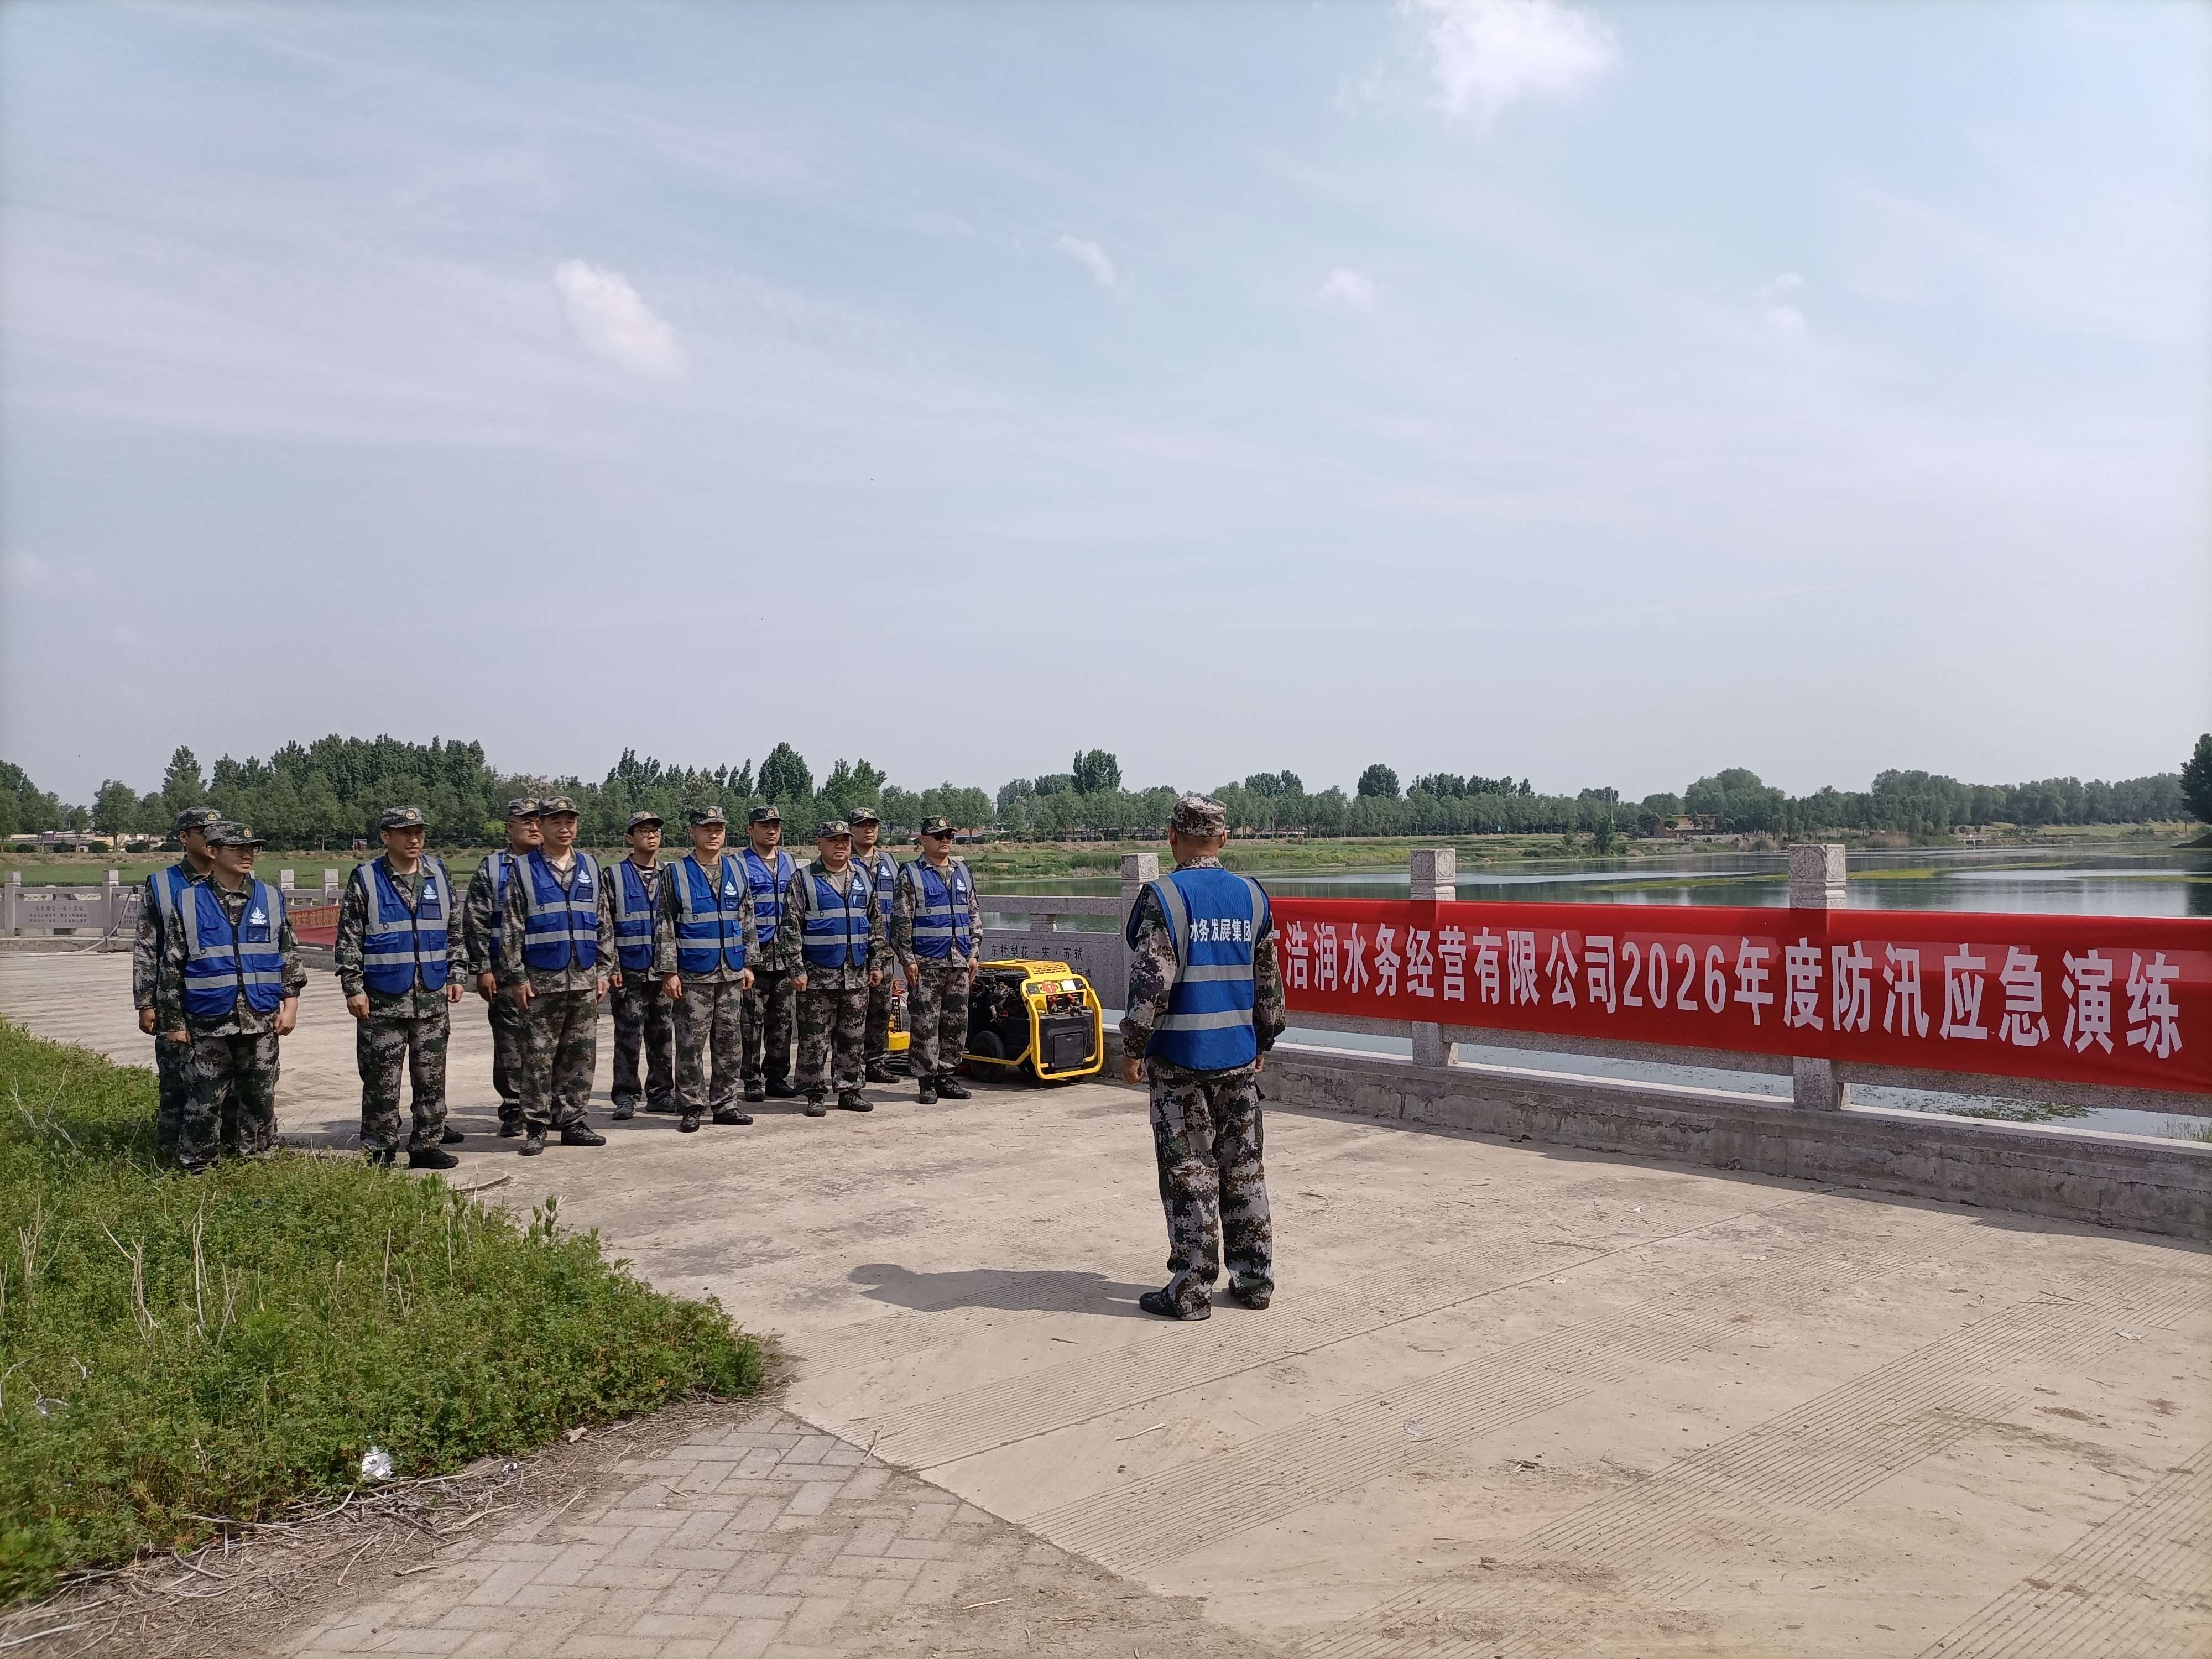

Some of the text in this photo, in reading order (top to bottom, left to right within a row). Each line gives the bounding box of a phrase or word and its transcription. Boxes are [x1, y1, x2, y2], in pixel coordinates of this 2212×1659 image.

[1190, 918, 1251, 942] 水务发展集团
[1274, 920, 2182, 1058] 浩润水务经营有限公司2026年度防汛应急演练
